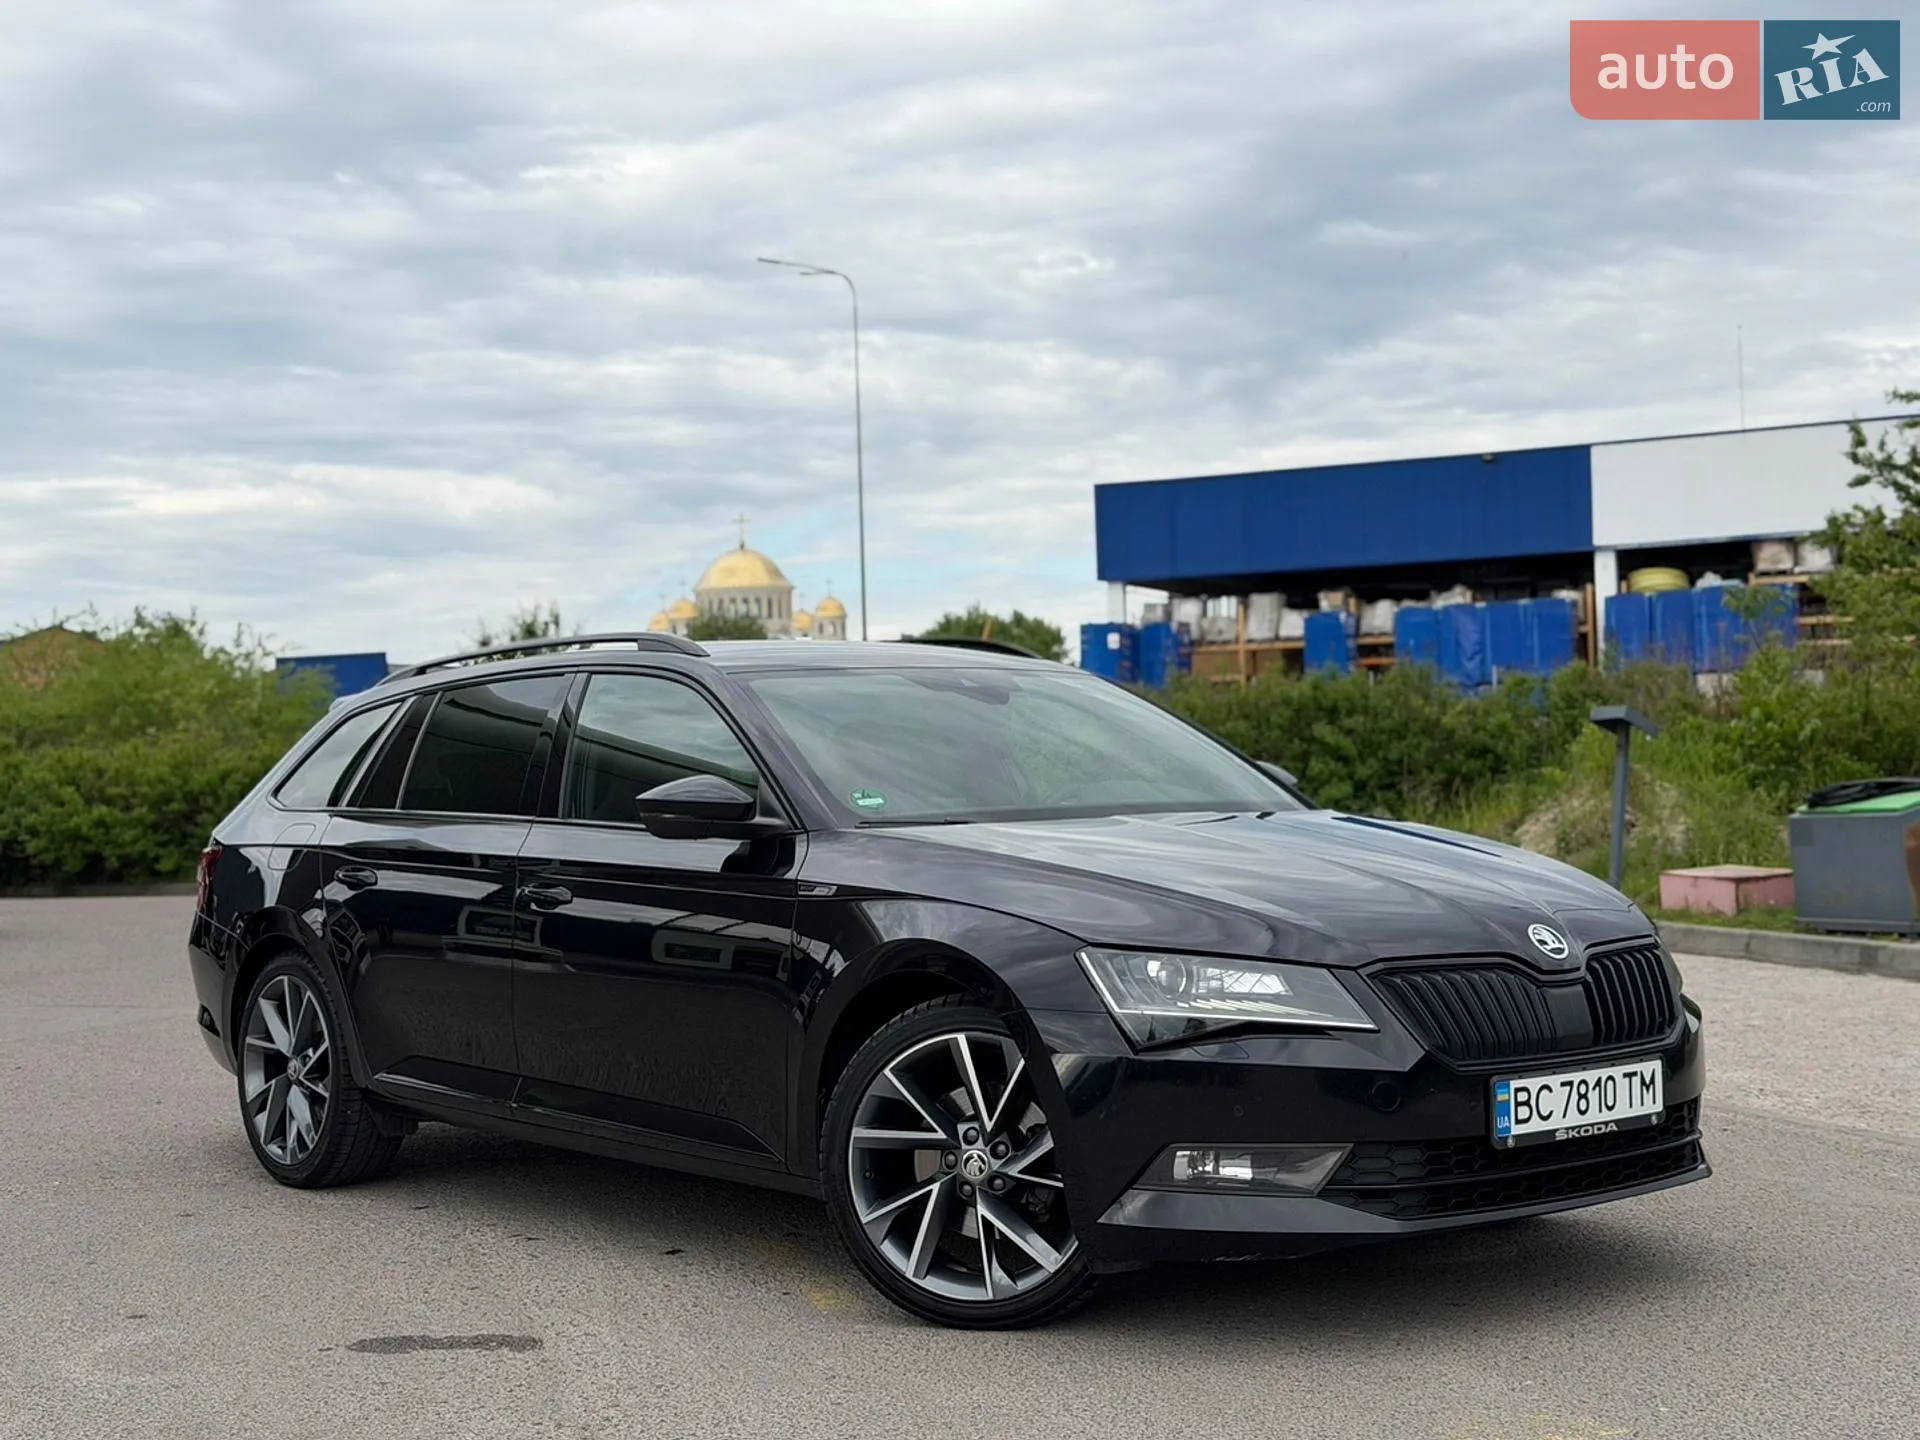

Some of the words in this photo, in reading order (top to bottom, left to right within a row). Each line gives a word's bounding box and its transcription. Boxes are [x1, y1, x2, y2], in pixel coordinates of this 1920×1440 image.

[1514, 1084, 1554, 1125] BC
[1560, 1075, 1616, 1119] 7810
[1623, 1068, 1656, 1108] TM
[1497, 1115, 1510, 1128] UA
